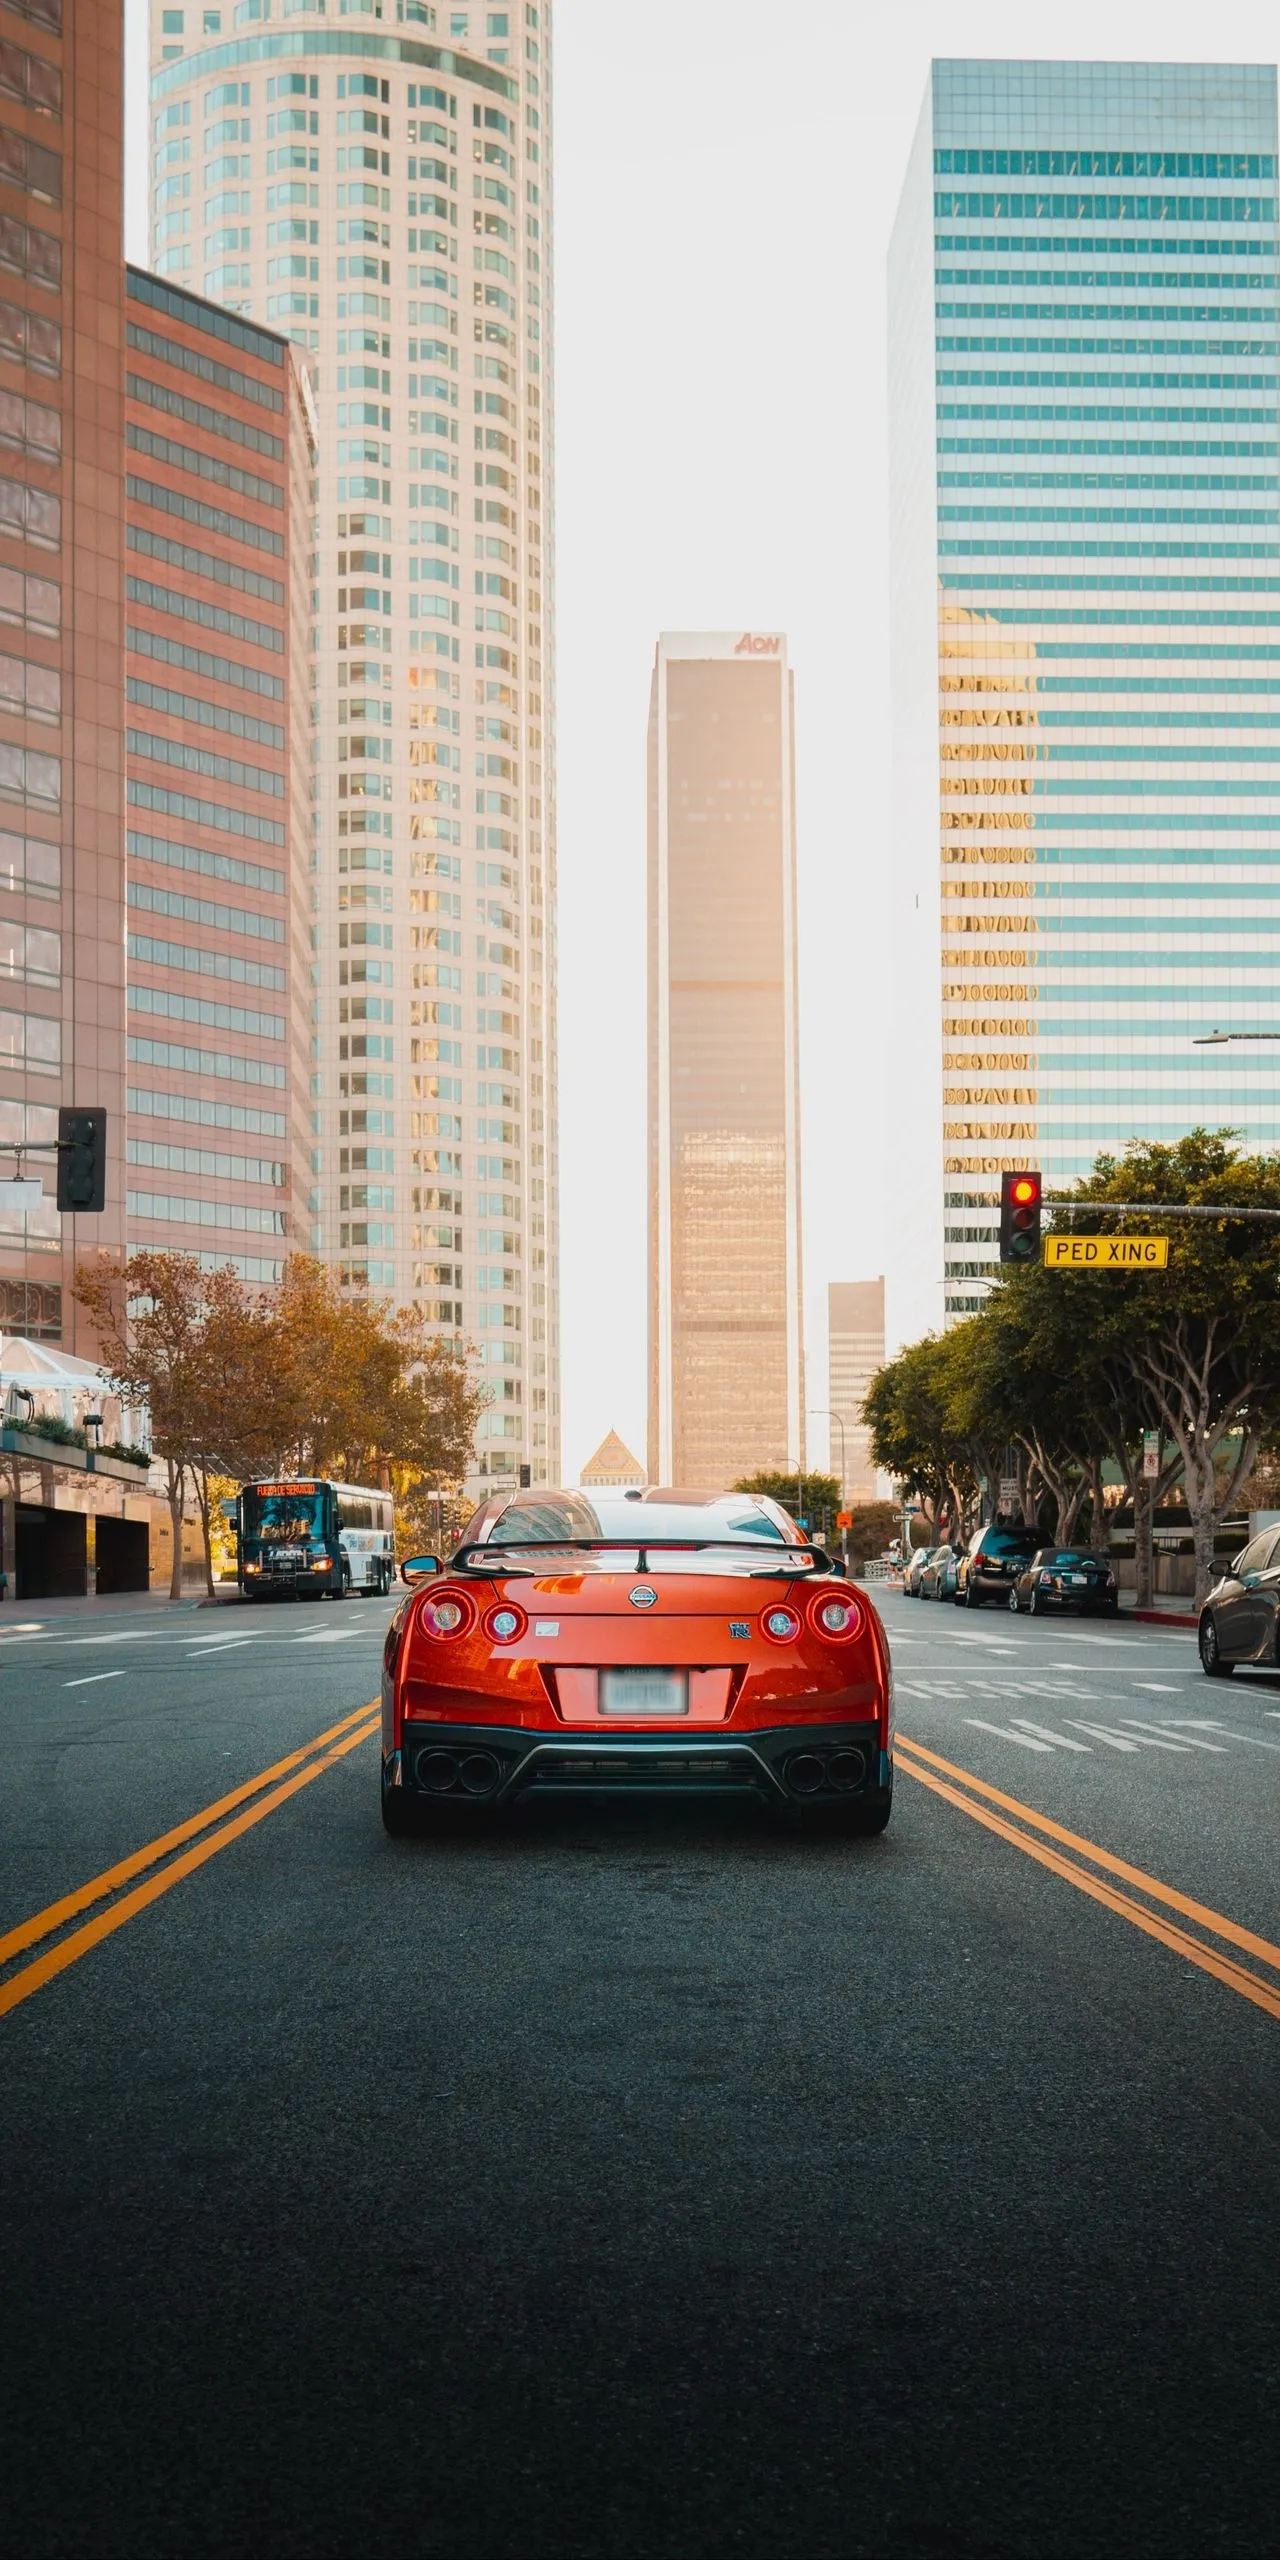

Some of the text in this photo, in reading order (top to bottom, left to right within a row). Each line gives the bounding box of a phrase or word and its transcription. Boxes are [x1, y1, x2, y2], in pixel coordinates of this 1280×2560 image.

[1056, 1243, 1157, 1261] PED XING
[257, 1485, 276, 1496] FUERA
[277, 1485, 286, 1495] DE
[962, 1719, 1280, 1752] WAIT
